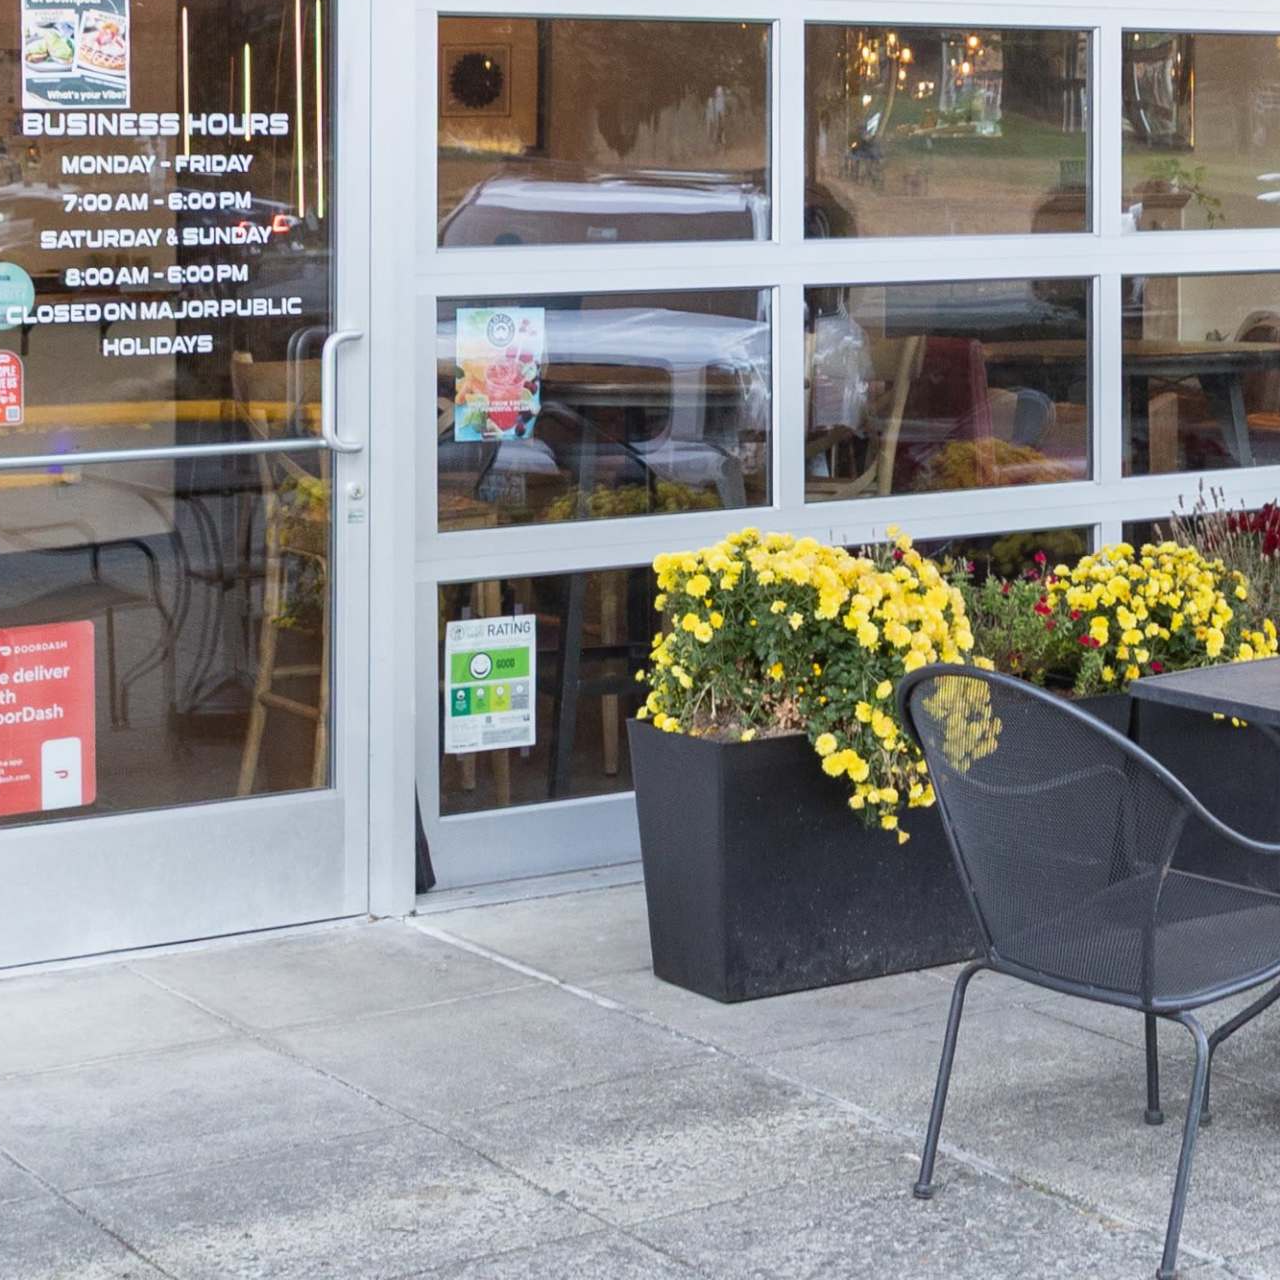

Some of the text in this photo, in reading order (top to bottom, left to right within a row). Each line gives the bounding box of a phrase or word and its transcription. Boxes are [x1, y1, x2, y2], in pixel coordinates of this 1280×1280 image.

[81, 91, 101, 101] your
[22, 112, 289, 137] BUSINESS HOURS
[61, 154, 156, 175] MONDAY
[175, 153, 254, 175] FRIDAY
[63, 193, 113, 214] 7:00
[115, 192, 149, 212] AM
[168, 192, 217, 211] 6:00
[220, 191, 252, 210] PM
[40, 225, 273, 250] SATURDAY & SUNDAY
[65, 267, 114, 287] 8:00
[115, 266, 150, 285] AM
[167, 265, 215, 284] 6:00
[217, 264, 249, 283] PM
[6, 296, 303, 325] CLOSED ON MAJOR PUBLIC
[104, 335, 213, 356] HOLIDAYS
[488, 622, 530, 636] RATING
[14, 641, 67, 653] DOORDASH
[13, 666, 69, 683] deliver
